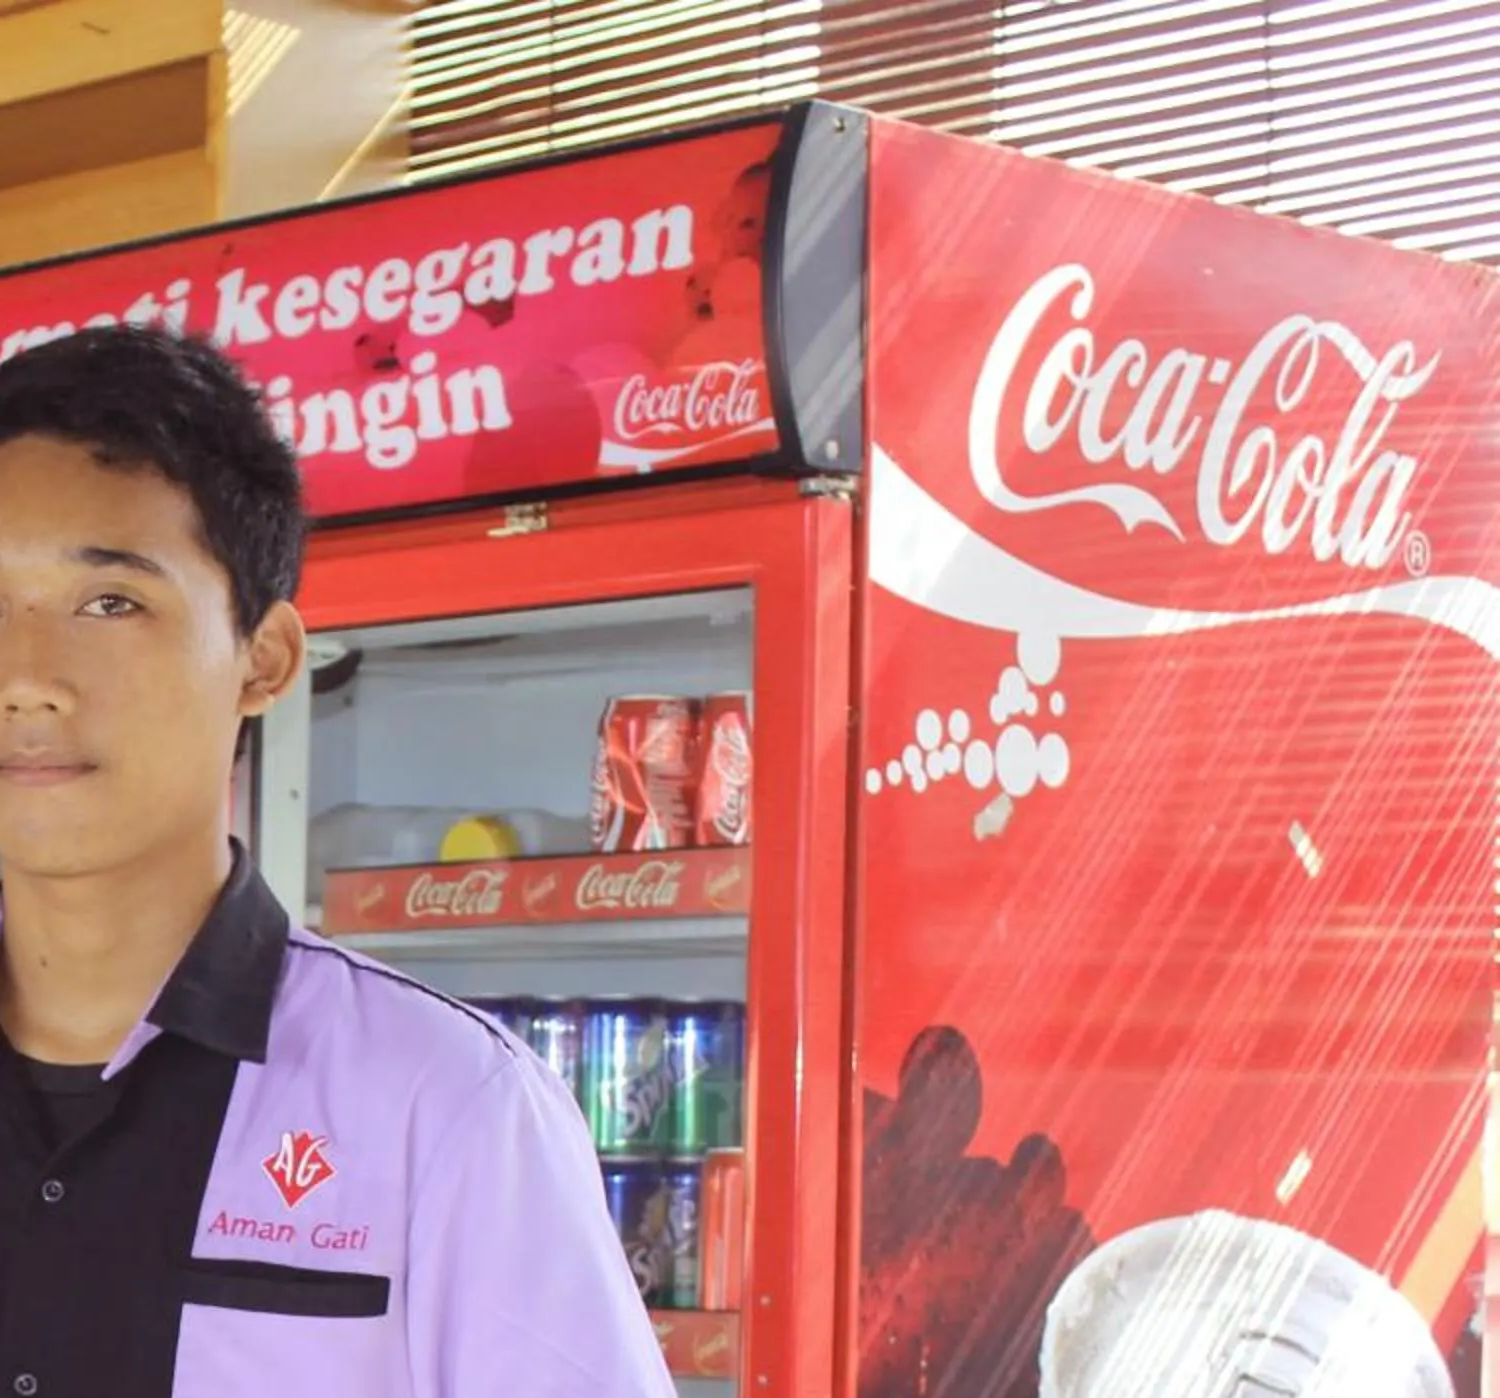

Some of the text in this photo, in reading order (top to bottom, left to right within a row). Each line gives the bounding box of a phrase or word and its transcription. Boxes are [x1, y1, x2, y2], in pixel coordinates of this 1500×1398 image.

[215, 204, 694, 348] kesegaran
[248, 350, 514, 470] ingin
[613, 358, 765, 440] Coca-Cola
[968, 262, 1443, 571] Coca-Cola
[405, 868, 510, 918] Coca-Cola
[576, 860, 687, 912] Coca-Cola
[273, 1132, 329, 1188] AG
[208, 1210, 370, 1251] Aman Gati
